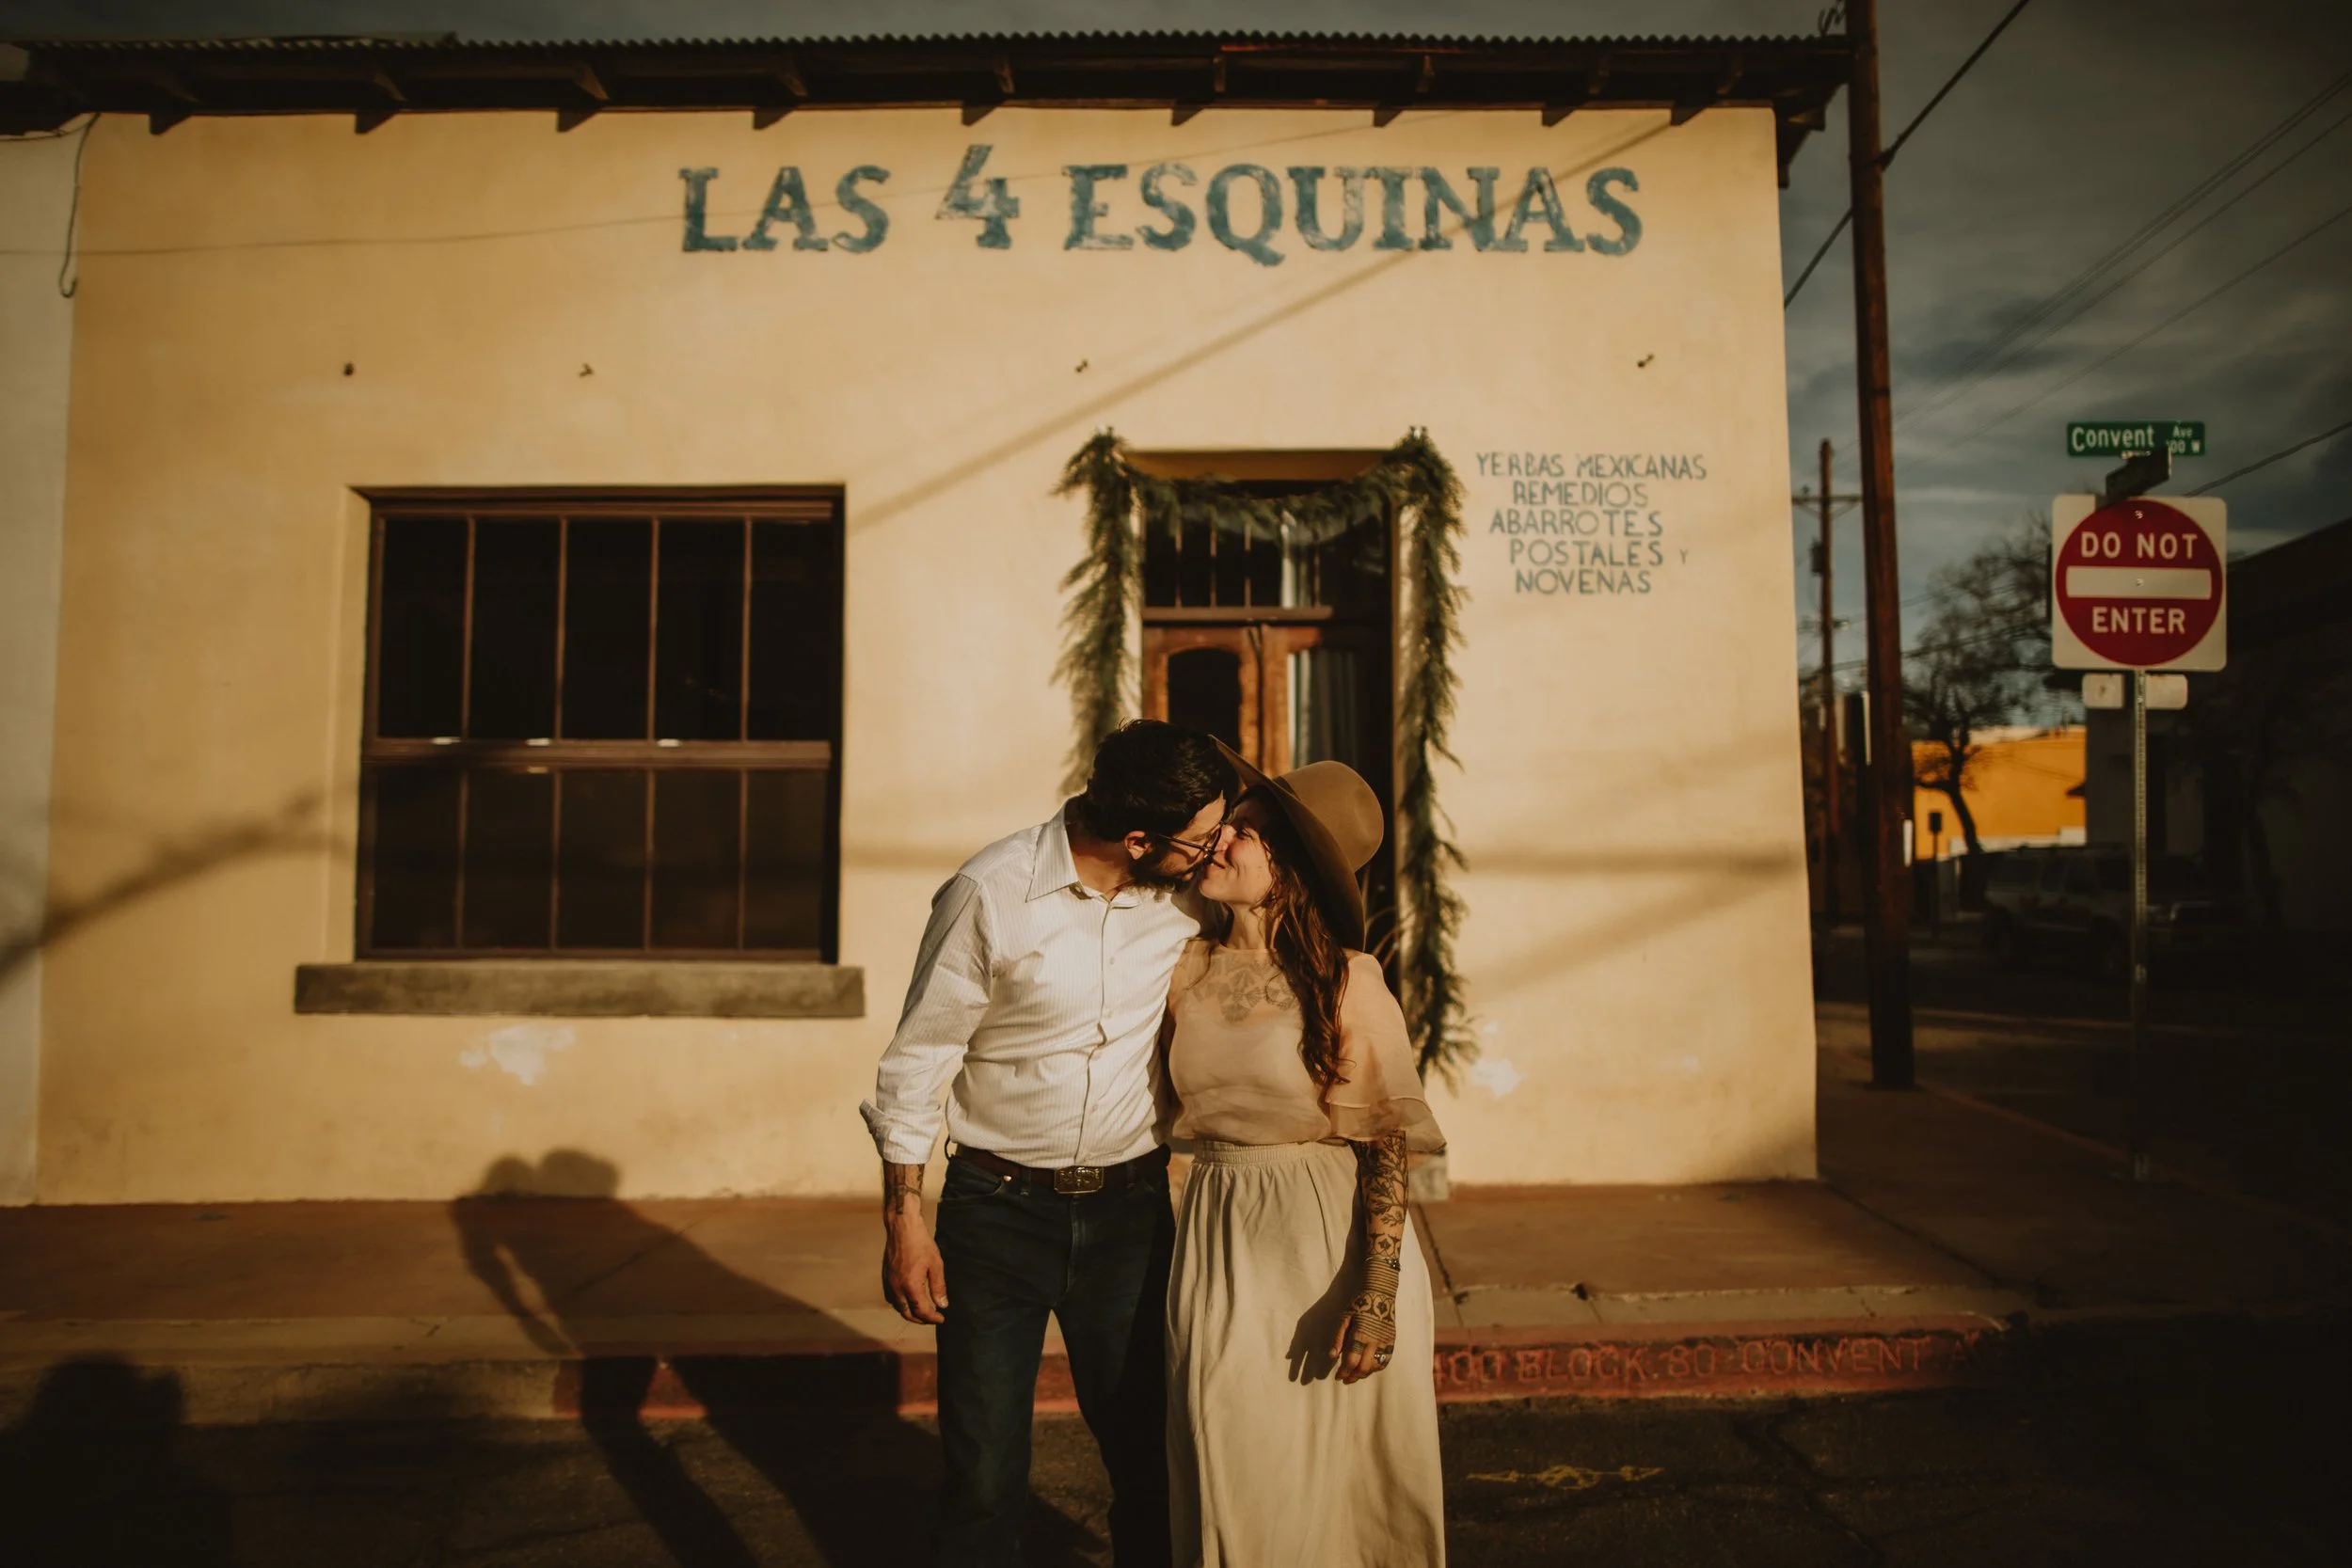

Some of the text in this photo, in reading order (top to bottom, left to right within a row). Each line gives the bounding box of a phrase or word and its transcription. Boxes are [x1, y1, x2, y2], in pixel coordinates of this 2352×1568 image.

[678, 144, 1643, 266] LAS 4 ESQUINAS
[2072, 426, 2154, 452] Convent
[2172, 424, 2193, 438] Ave
[1475, 451, 1708, 481] YERBAS MEXICANAS
[1512, 481, 1648, 508] REMEDIOS
[1488, 508, 1663, 537] ABARROTES
[1509, 538, 1663, 567] POSTALES
[2080, 531, 2198, 560] DO NOT
[1515, 568, 1652, 595] NOVENAS
[2091, 607, 2186, 634] ENTER
[1515, 1343, 1652, 1385] BLOCK
[1742, 1335, 1933, 1375] CONVENT
